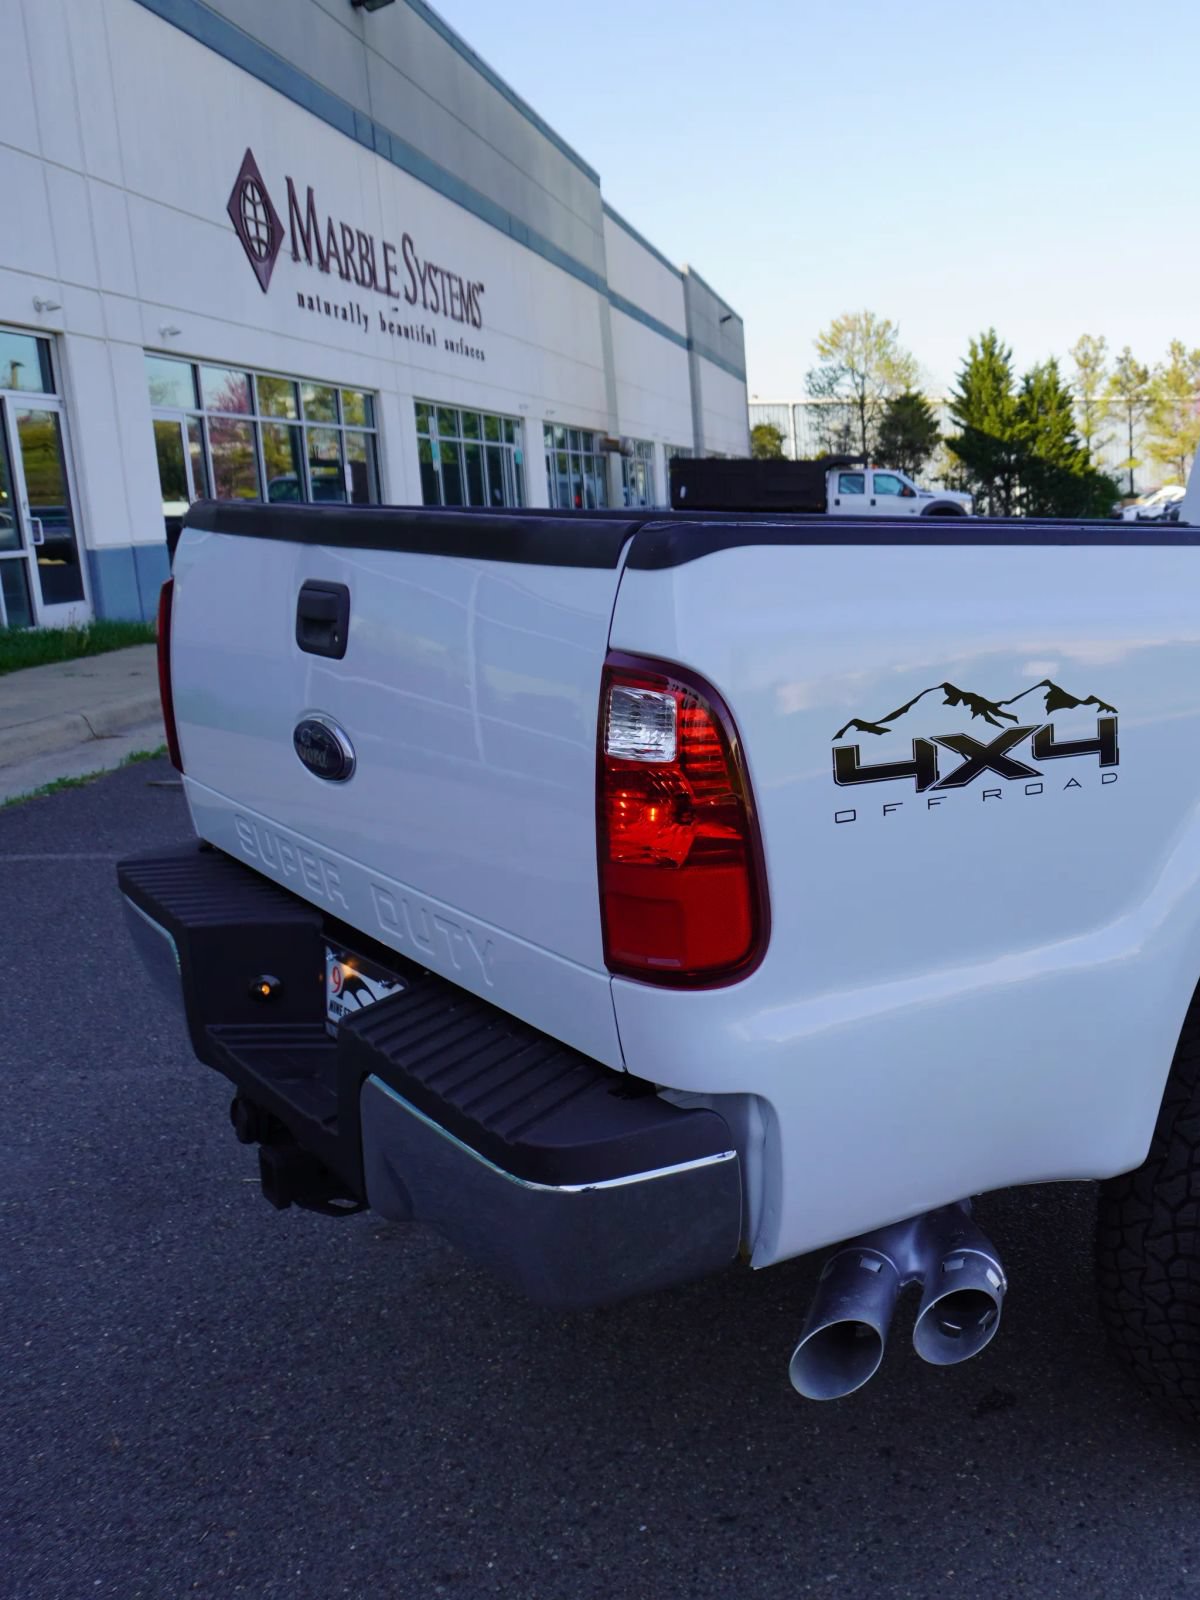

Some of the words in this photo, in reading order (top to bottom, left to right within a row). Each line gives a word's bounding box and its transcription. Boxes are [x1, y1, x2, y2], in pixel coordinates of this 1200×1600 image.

[285, 175, 400, 299] MARBLE
[297, 292, 369, 333] naturally
[379, 309, 437, 347] beautiful
[444, 337, 485, 361] surfaces
[235, 813, 350, 911] SUPER
[371, 882, 496, 987] DUTY
[331, 966, 342, 993] 9
